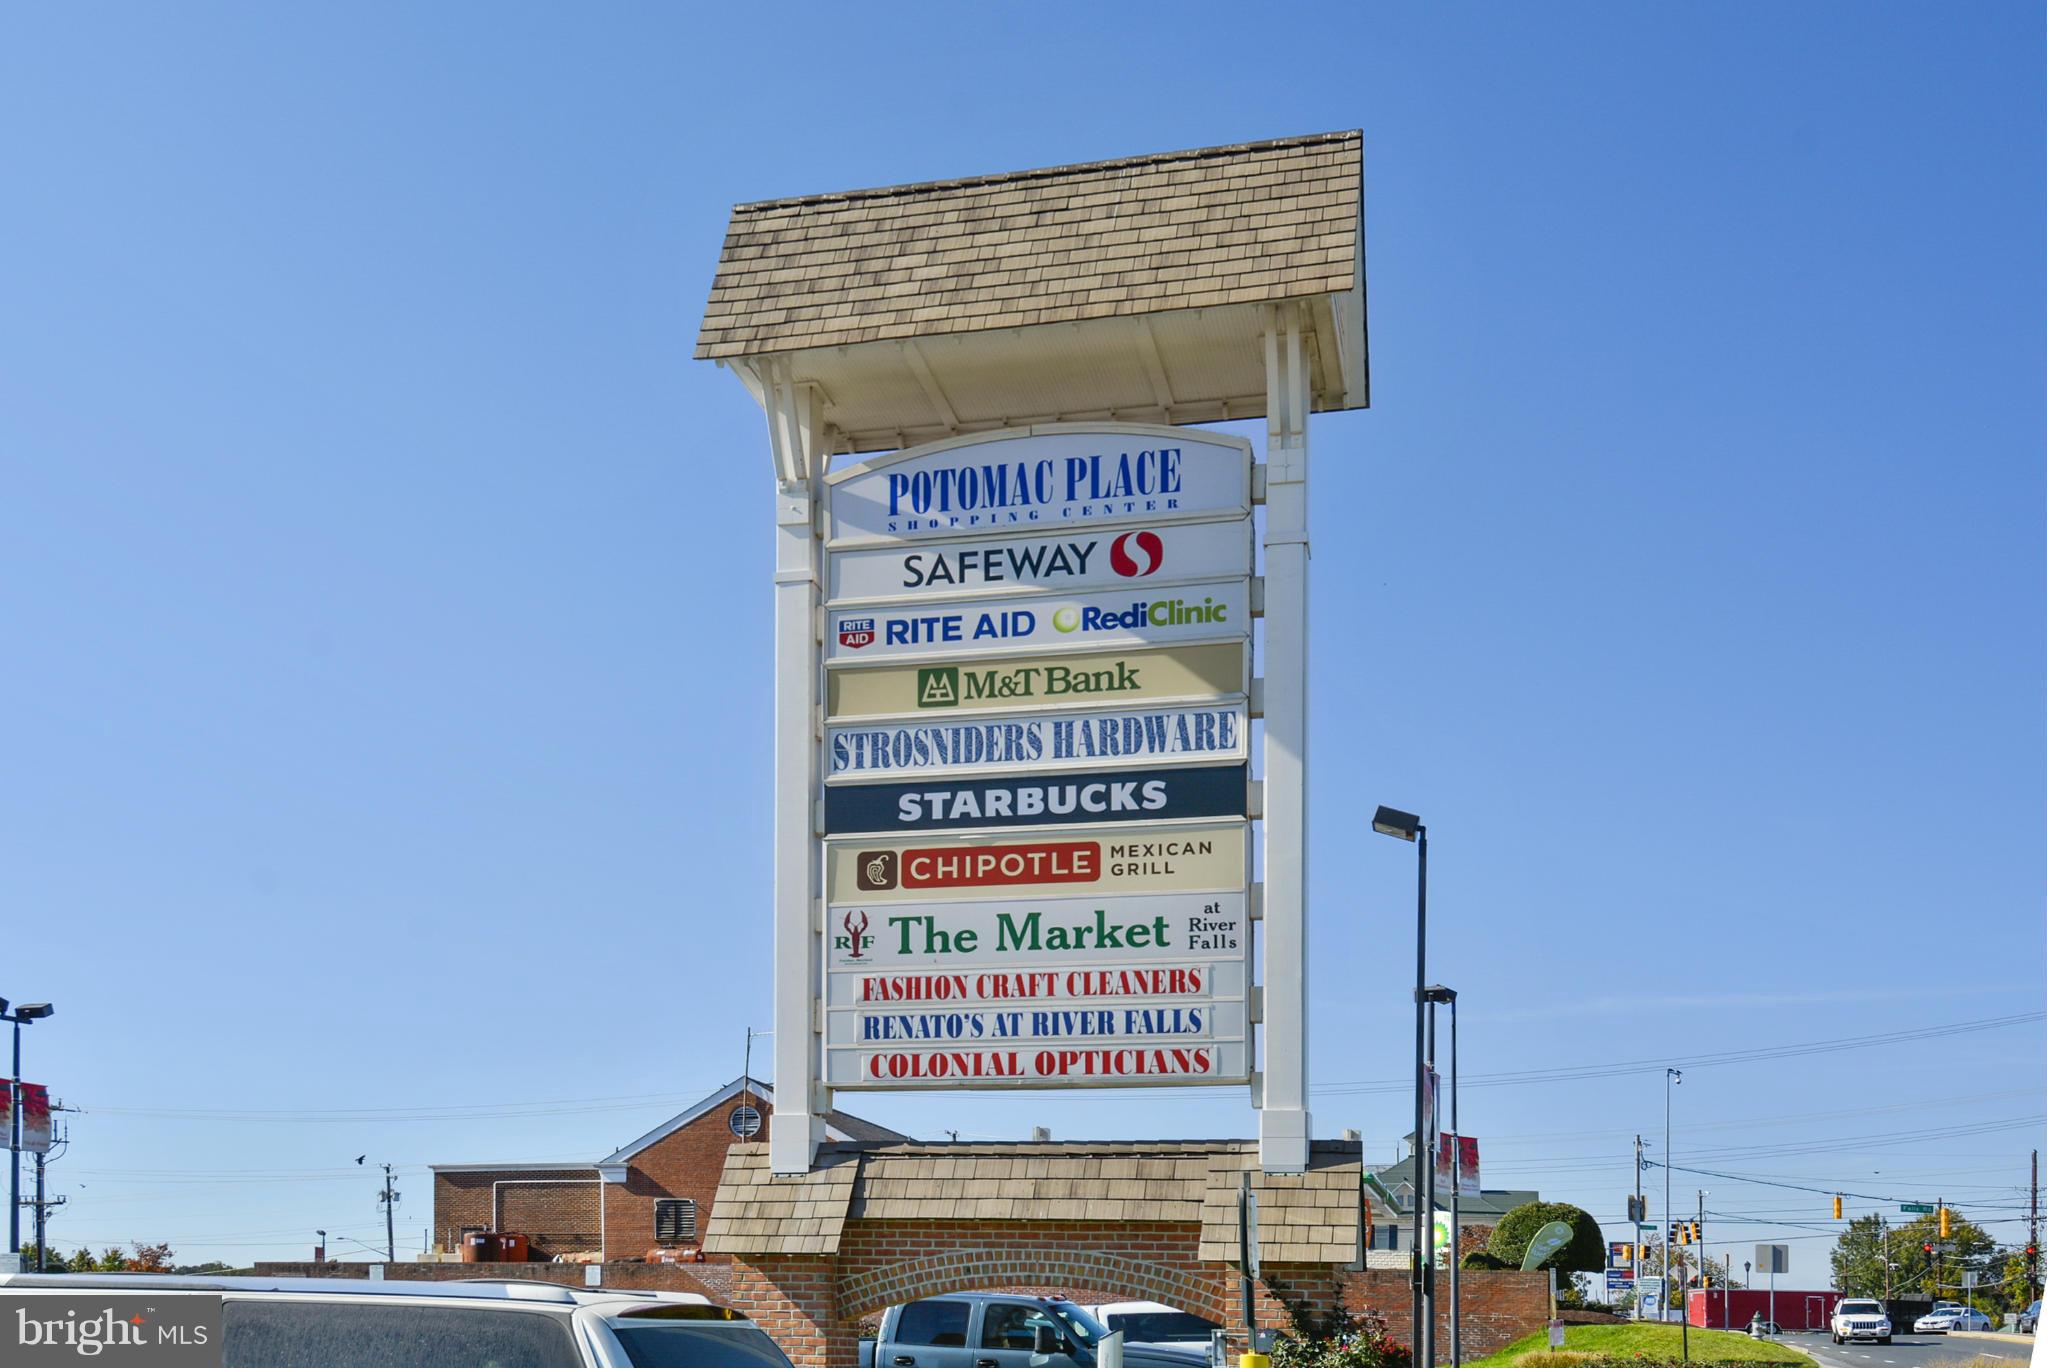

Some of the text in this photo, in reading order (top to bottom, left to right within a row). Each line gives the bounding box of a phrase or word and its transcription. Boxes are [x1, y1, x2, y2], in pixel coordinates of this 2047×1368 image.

[888, 448, 1181, 517] POTOMAC PLACE
[888, 499, 1180, 532] SHOPPING CENTER
[902, 541, 1098, 588] SAFEWAY
[842, 620, 870, 632] RITE
[886, 610, 1036, 645] RITE AID
[1082, 597, 1227, 632] RediClinic
[845, 632, 869, 645] AID
[963, 661, 1141, 700] M&T Bank
[832, 711, 1237, 771] STROSNIDERS HARDWARE
[898, 780, 1167, 821] STARBUCKS
[910, 850, 1092, 880] CHIPOTLE
[1110, 841, 1212, 858] MEXICAN
[1111, 861, 1175, 876] GRILL
[1204, 902, 1220, 914] at
[888, 910, 1170, 955] The Market
[1189, 918, 1236, 932] River
[1189, 933, 1237, 950] Falls
[862, 967, 1201, 1001] FASHION CRAFT CLEANERS
[863, 1008, 1201, 1040] RENATO'S AT RIVER FALLS
[870, 1048, 1211, 1079] COLONIAL OPTICIANS
